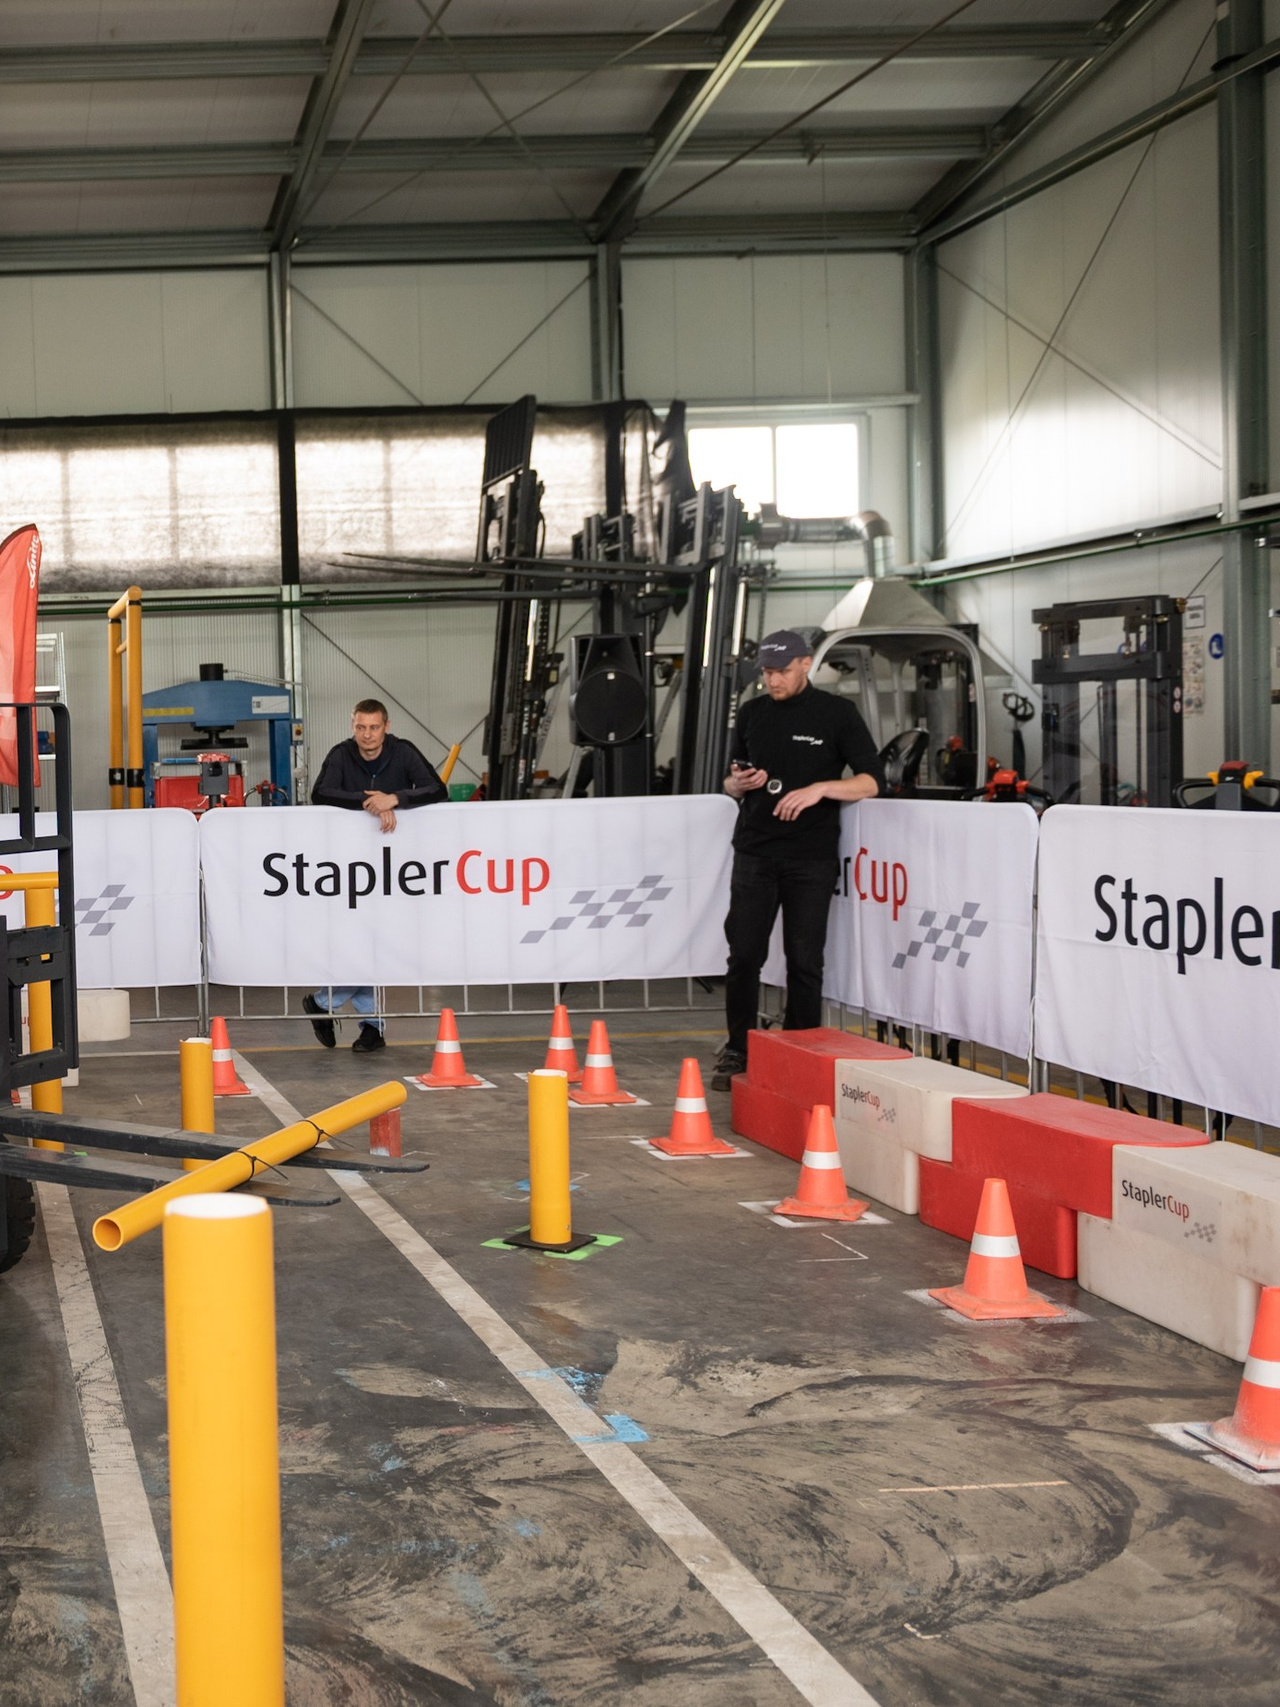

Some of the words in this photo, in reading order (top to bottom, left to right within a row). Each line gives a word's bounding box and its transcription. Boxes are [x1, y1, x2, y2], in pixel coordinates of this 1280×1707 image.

[262, 846, 550, 909] StaplerCup
[841, 1083, 880, 1111] StaplerCup
[1122, 1179, 1190, 1223] StaplerCup
